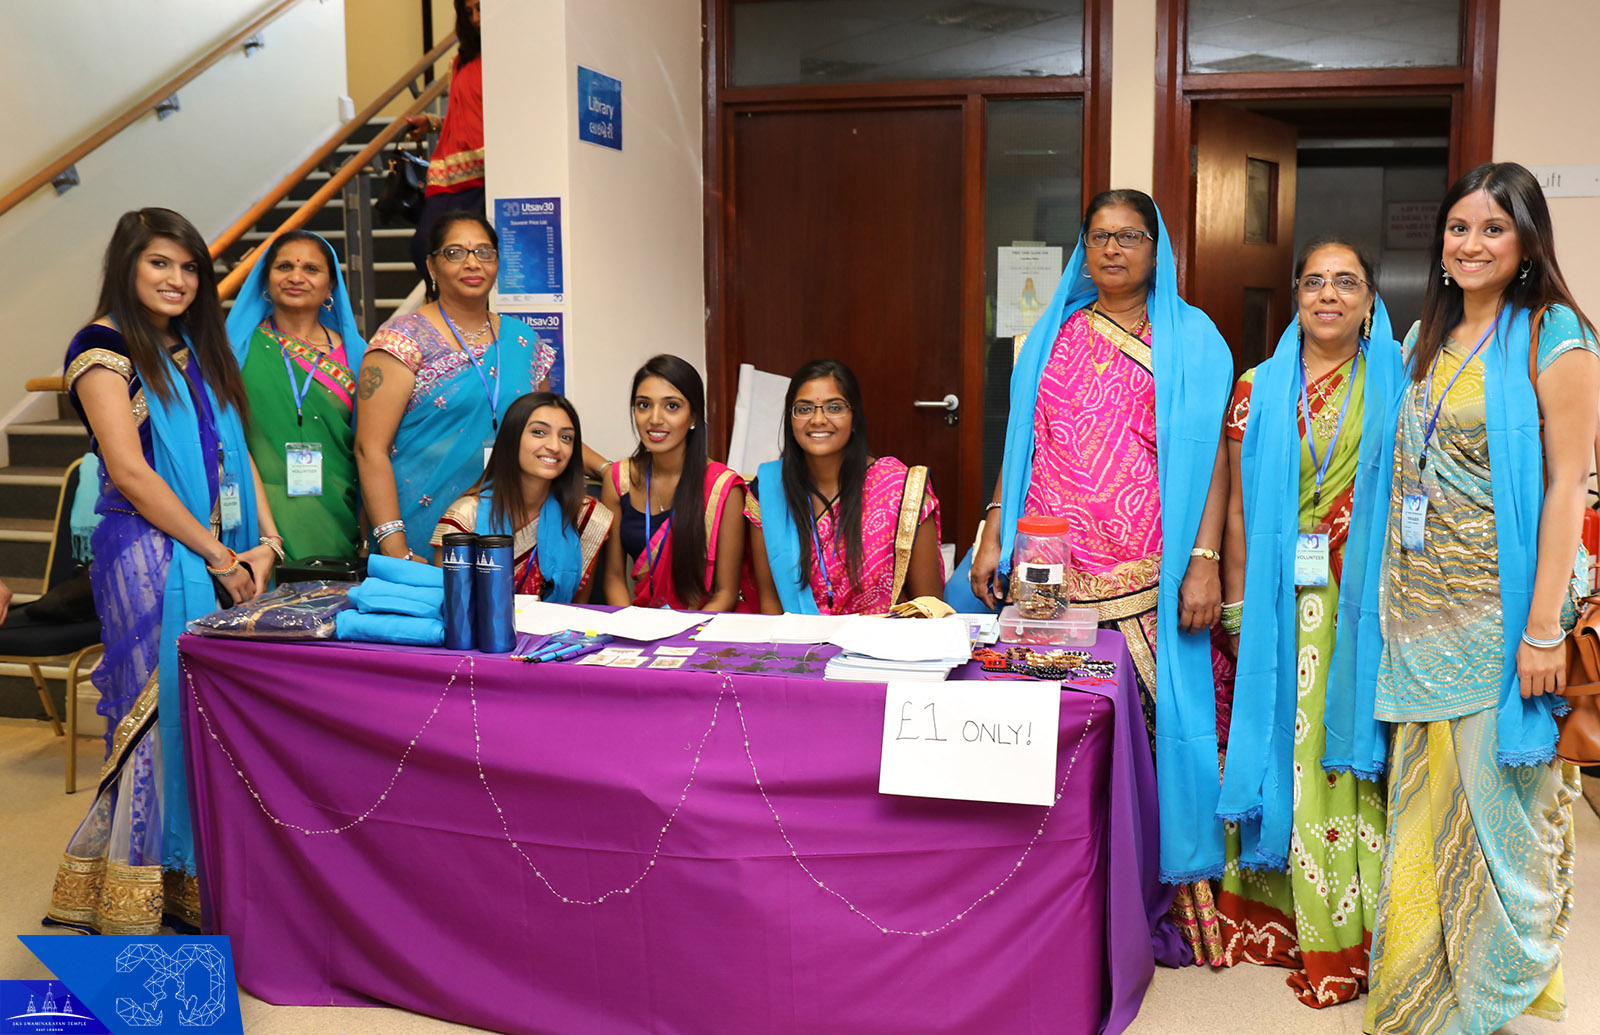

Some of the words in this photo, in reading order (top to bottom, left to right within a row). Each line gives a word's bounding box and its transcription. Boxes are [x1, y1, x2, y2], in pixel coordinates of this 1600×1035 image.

[588, 95, 614, 120] Library
[521, 202, 554, 212] Utsav30
[522, 316, 560, 326] Utsav30
[896, 700, 948, 741] £1
[962, 719, 1032, 746] ONLY!
